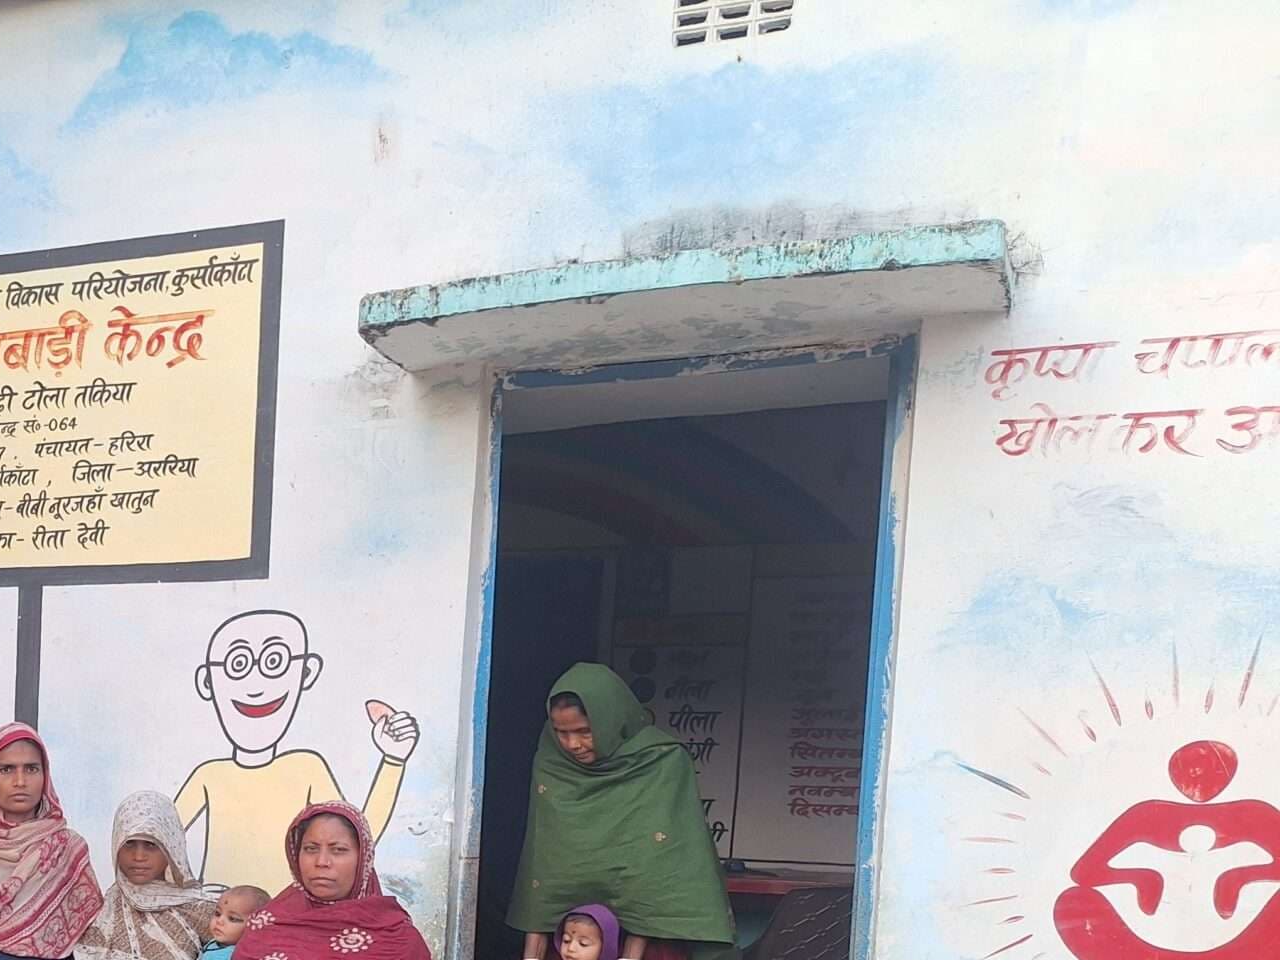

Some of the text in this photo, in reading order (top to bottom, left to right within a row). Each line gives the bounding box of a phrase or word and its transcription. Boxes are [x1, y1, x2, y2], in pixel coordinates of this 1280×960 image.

[6, 281, 64, 309] विकास
[104, 305, 215, 369] केन्द्र
[22, 380, 70, 410] टोला
[74, 377, 138, 408] तकिया
[110, 489, 160, 514] खातुन
[32, 525, 70, 550] रीता
[77, 519, 110, 550] देवी
[669, 704, 722, 733] पीला
